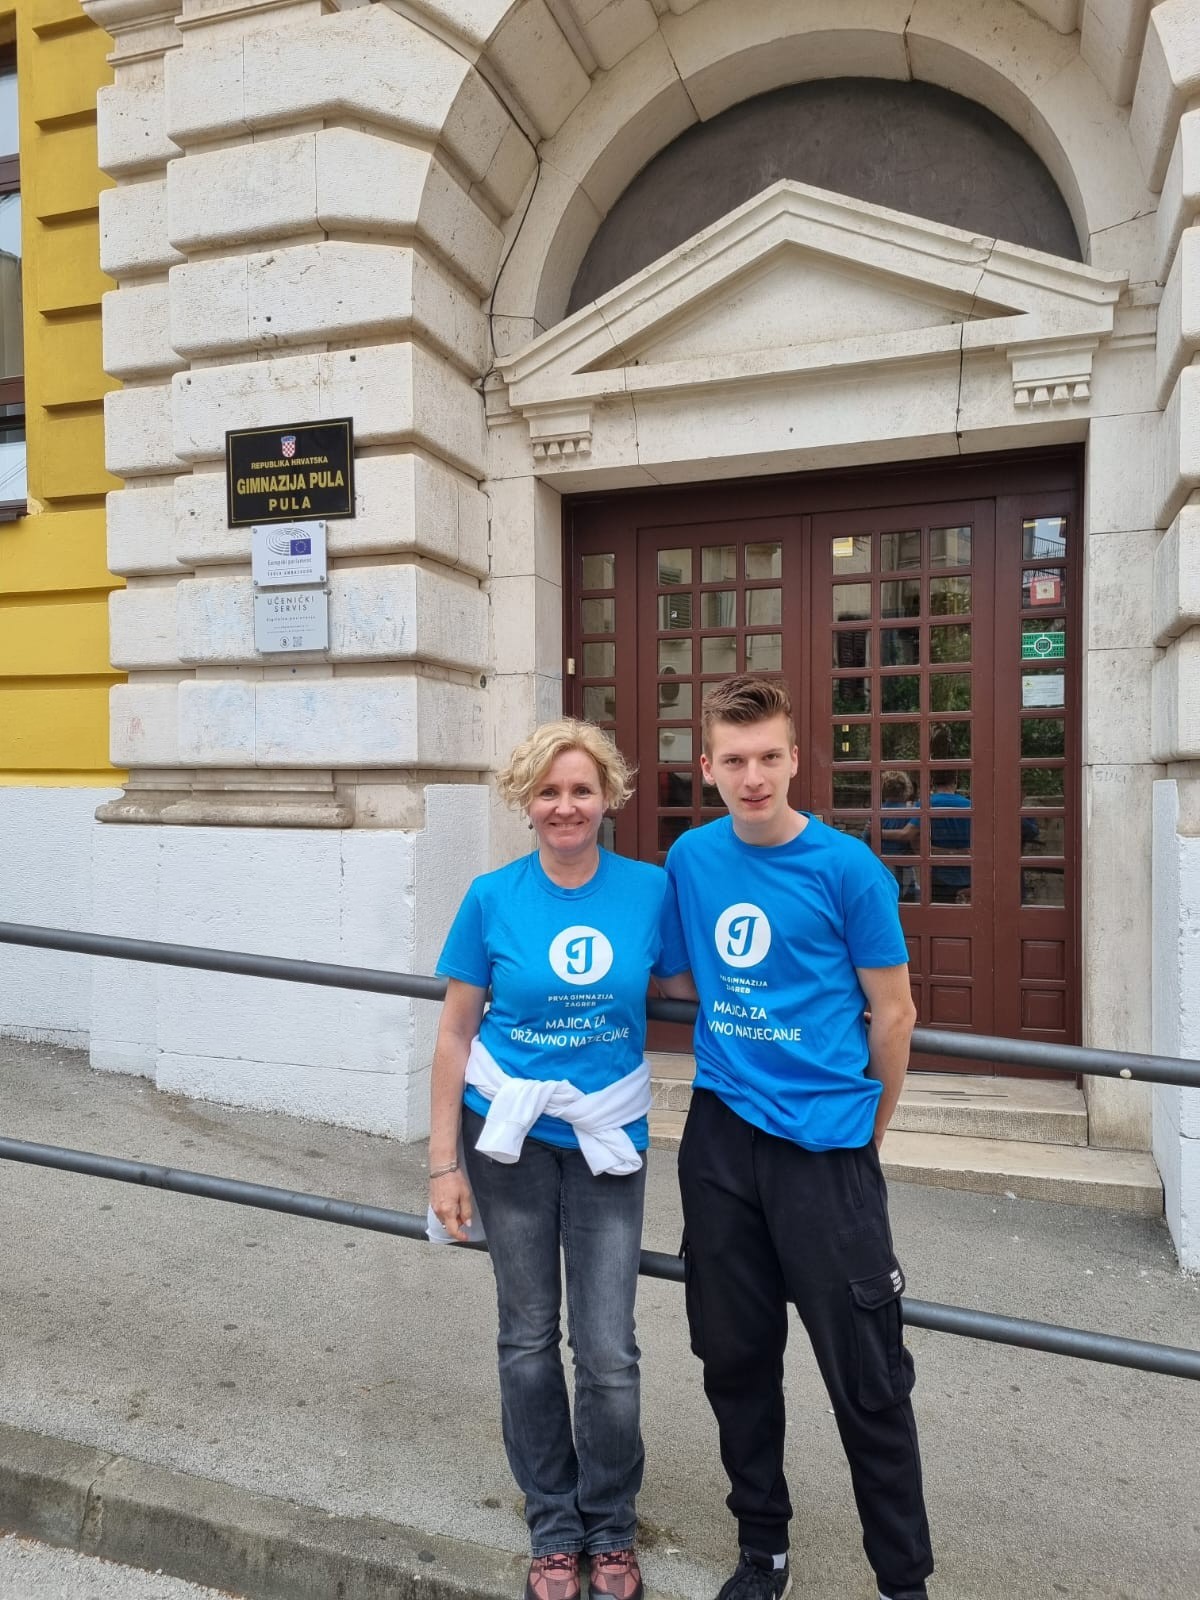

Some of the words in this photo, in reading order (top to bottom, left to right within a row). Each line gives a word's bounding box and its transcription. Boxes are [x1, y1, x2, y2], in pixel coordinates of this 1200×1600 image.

[251, 461, 290, 470] REPUBLIKA
[291, 456, 328, 466] HRVATSKA
[236, 473, 307, 495] GIMNAZIJA
[309, 470, 345, 489] PULA
[268, 495, 311, 512] PULA
[274, 603, 307, 613] SERVIS
[727, 976, 769, 988] GIMNAZIJA
[570, 993, 614, 1001] GIMNAZIJA
[713, 1000, 749, 1018] MAJICA
[750, 1006, 768, 1020] ZA
[545, 1017, 592, 1030] MAJICA
[593, 1013, 606, 1029] ZA
[569, 1027, 630, 1048] NATECNJE
[735, 1024, 802, 1041] NATJECANJE
